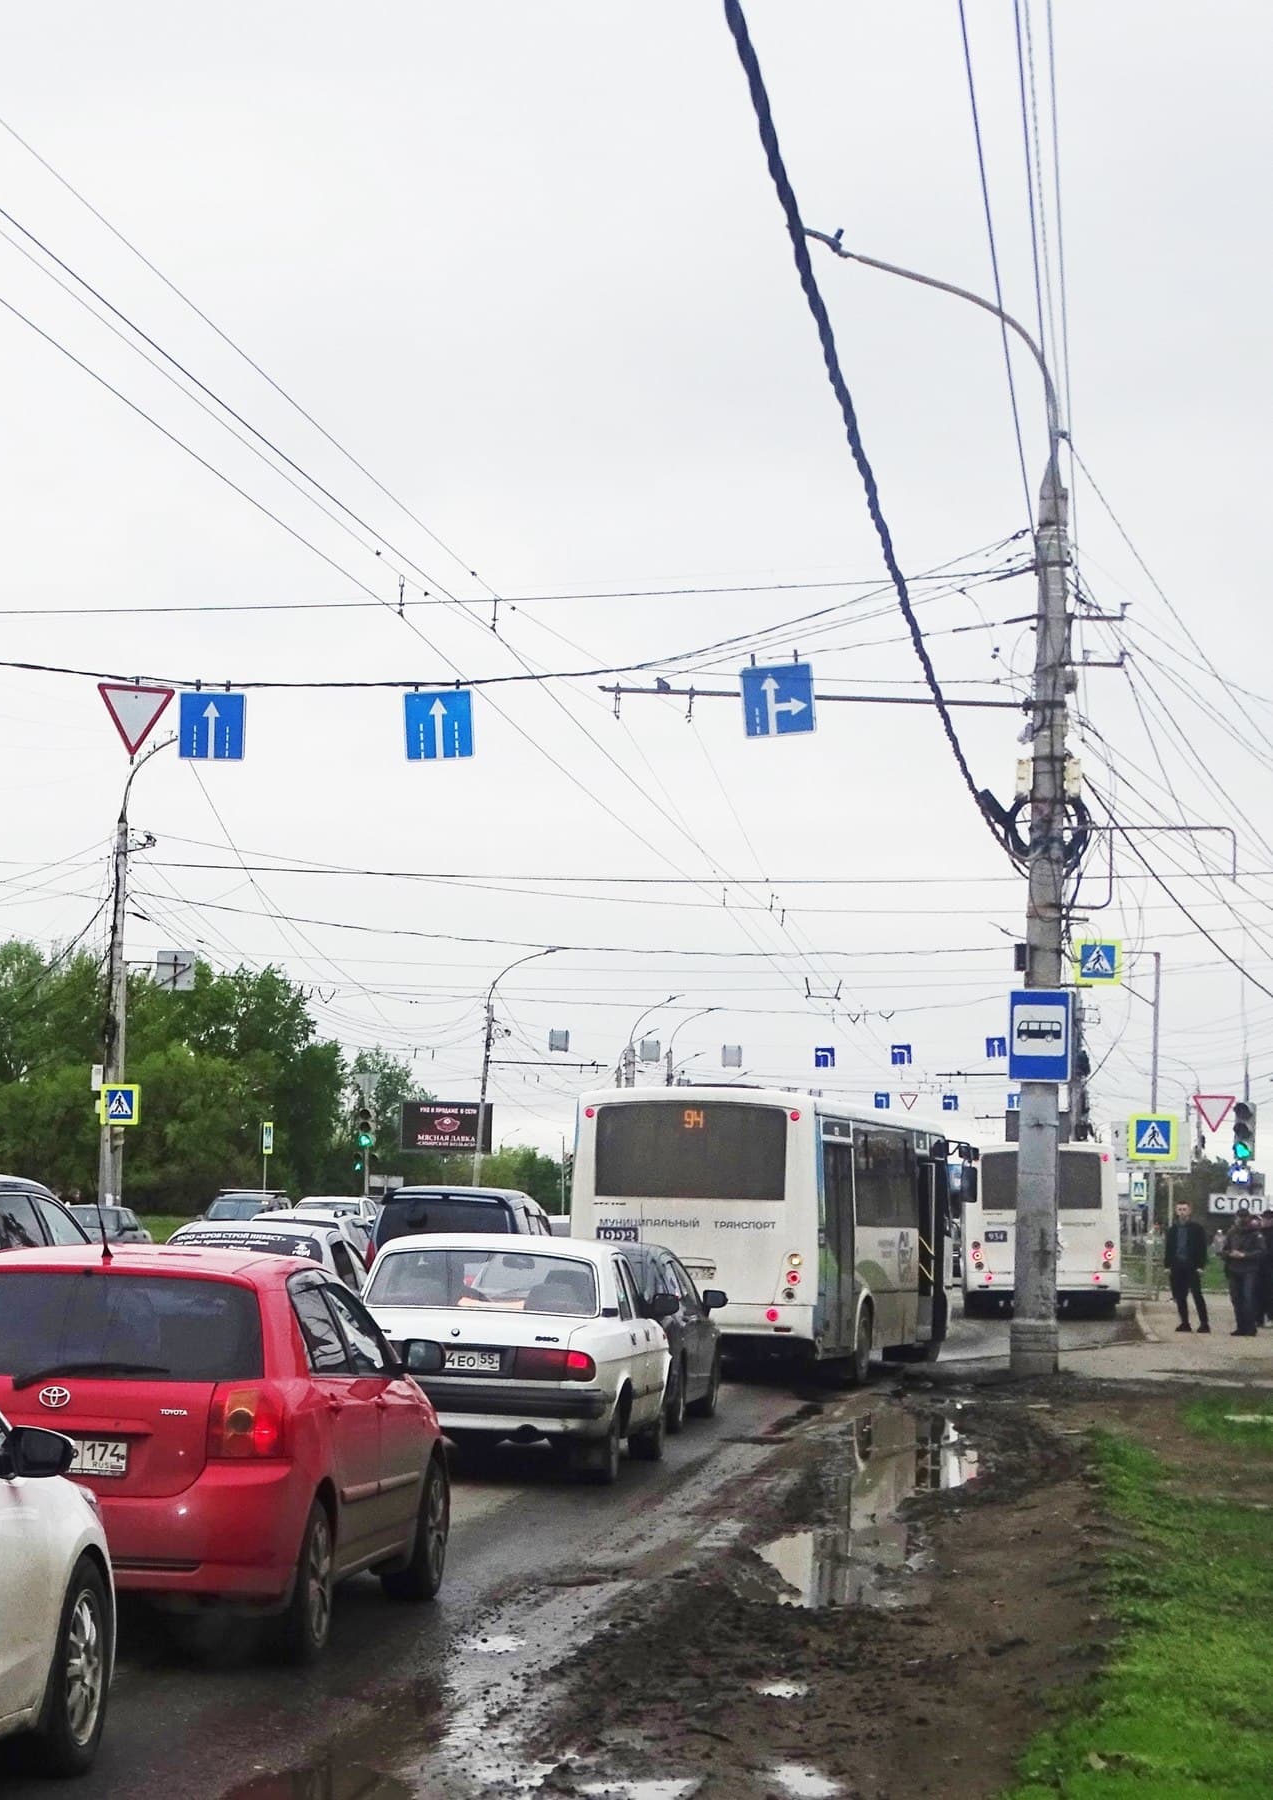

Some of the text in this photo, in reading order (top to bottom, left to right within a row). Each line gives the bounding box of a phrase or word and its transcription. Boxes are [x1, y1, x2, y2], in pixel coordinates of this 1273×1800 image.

[1214, 1196, 1263, 1212] СТОП
[599, 1216, 776, 1230] МУНИЦИПАЛЬНЫЙ ТРАНСПОРТ
[159, 1408, 188, 1416] TOYOTA
[86, 1442, 121, 1463] 174
